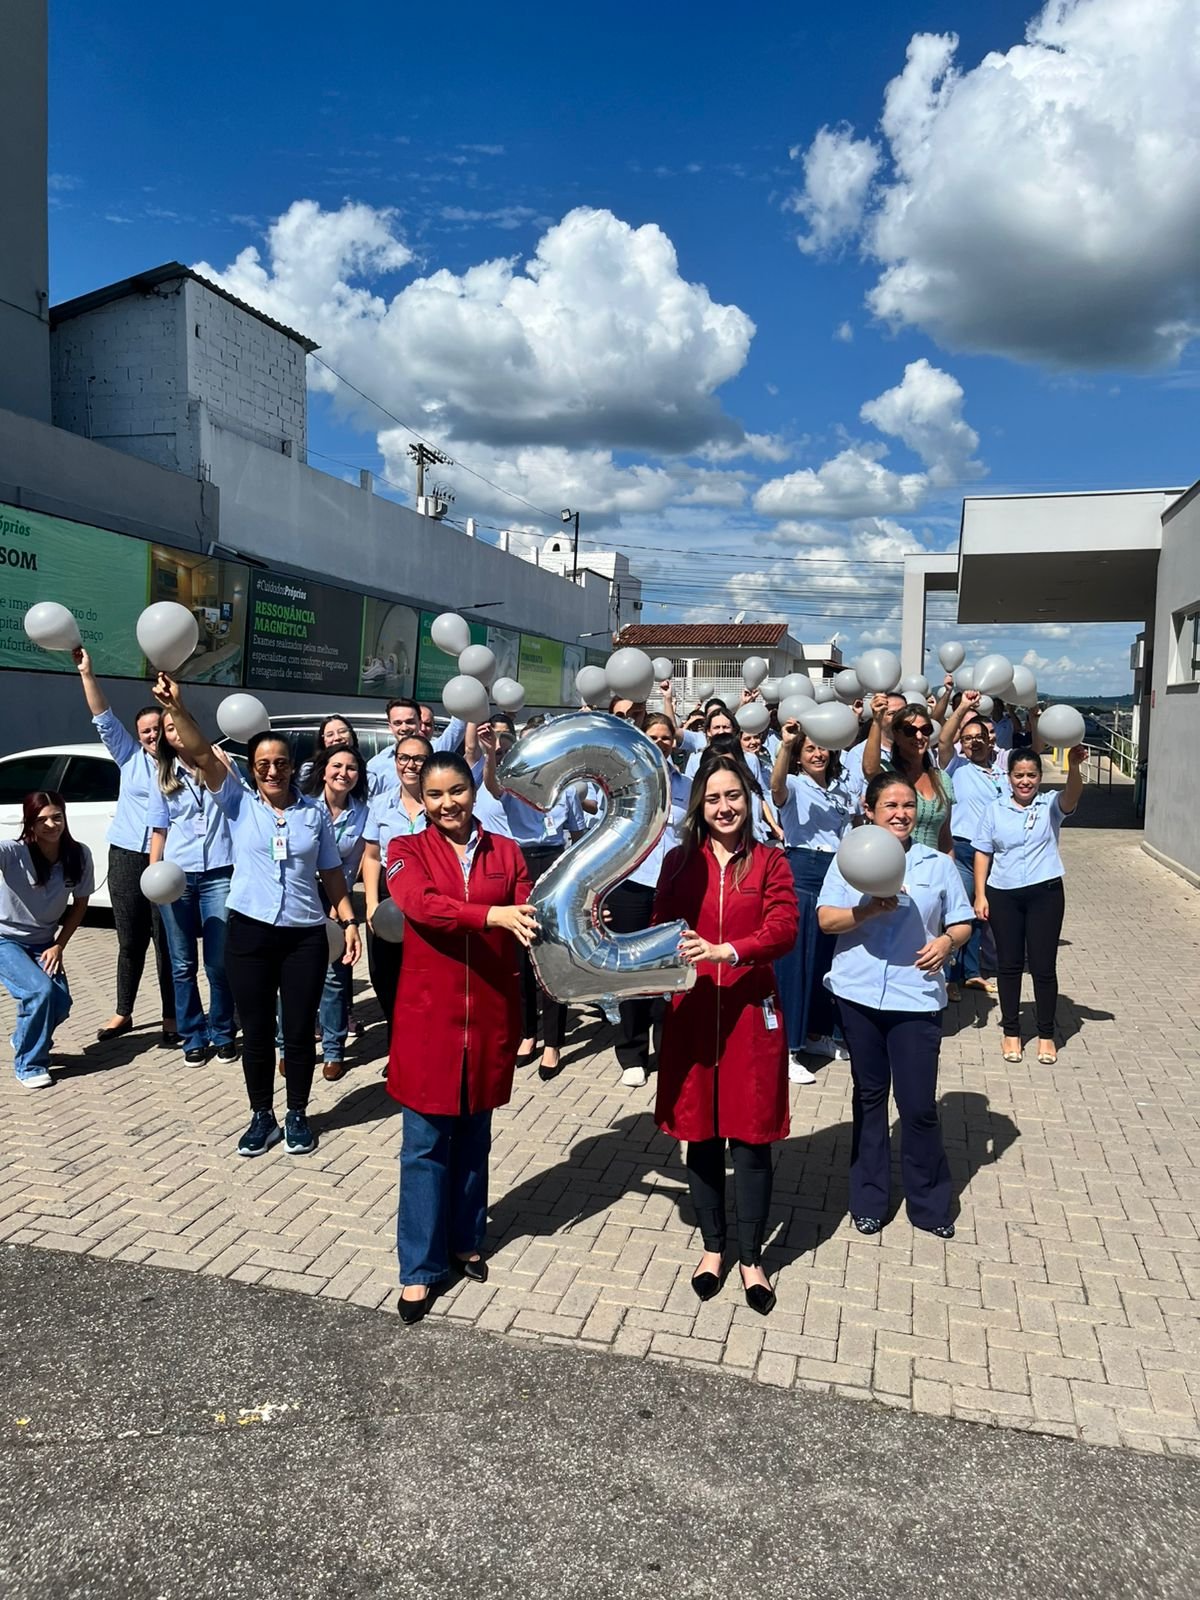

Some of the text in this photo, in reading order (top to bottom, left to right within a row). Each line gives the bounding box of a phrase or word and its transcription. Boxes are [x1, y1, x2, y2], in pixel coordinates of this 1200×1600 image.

[0, 546, 38, 571] SOM
[86, 608, 97, 621] do
[255, 601, 315, 624] RESSONÂNCIA
[79, 629, 104, 643] spaço
[252, 634, 275, 647] Exames
[288, 656, 300, 665] com
[255, 667, 285, 679] retaguarda
[285, 668, 293, 678] de
